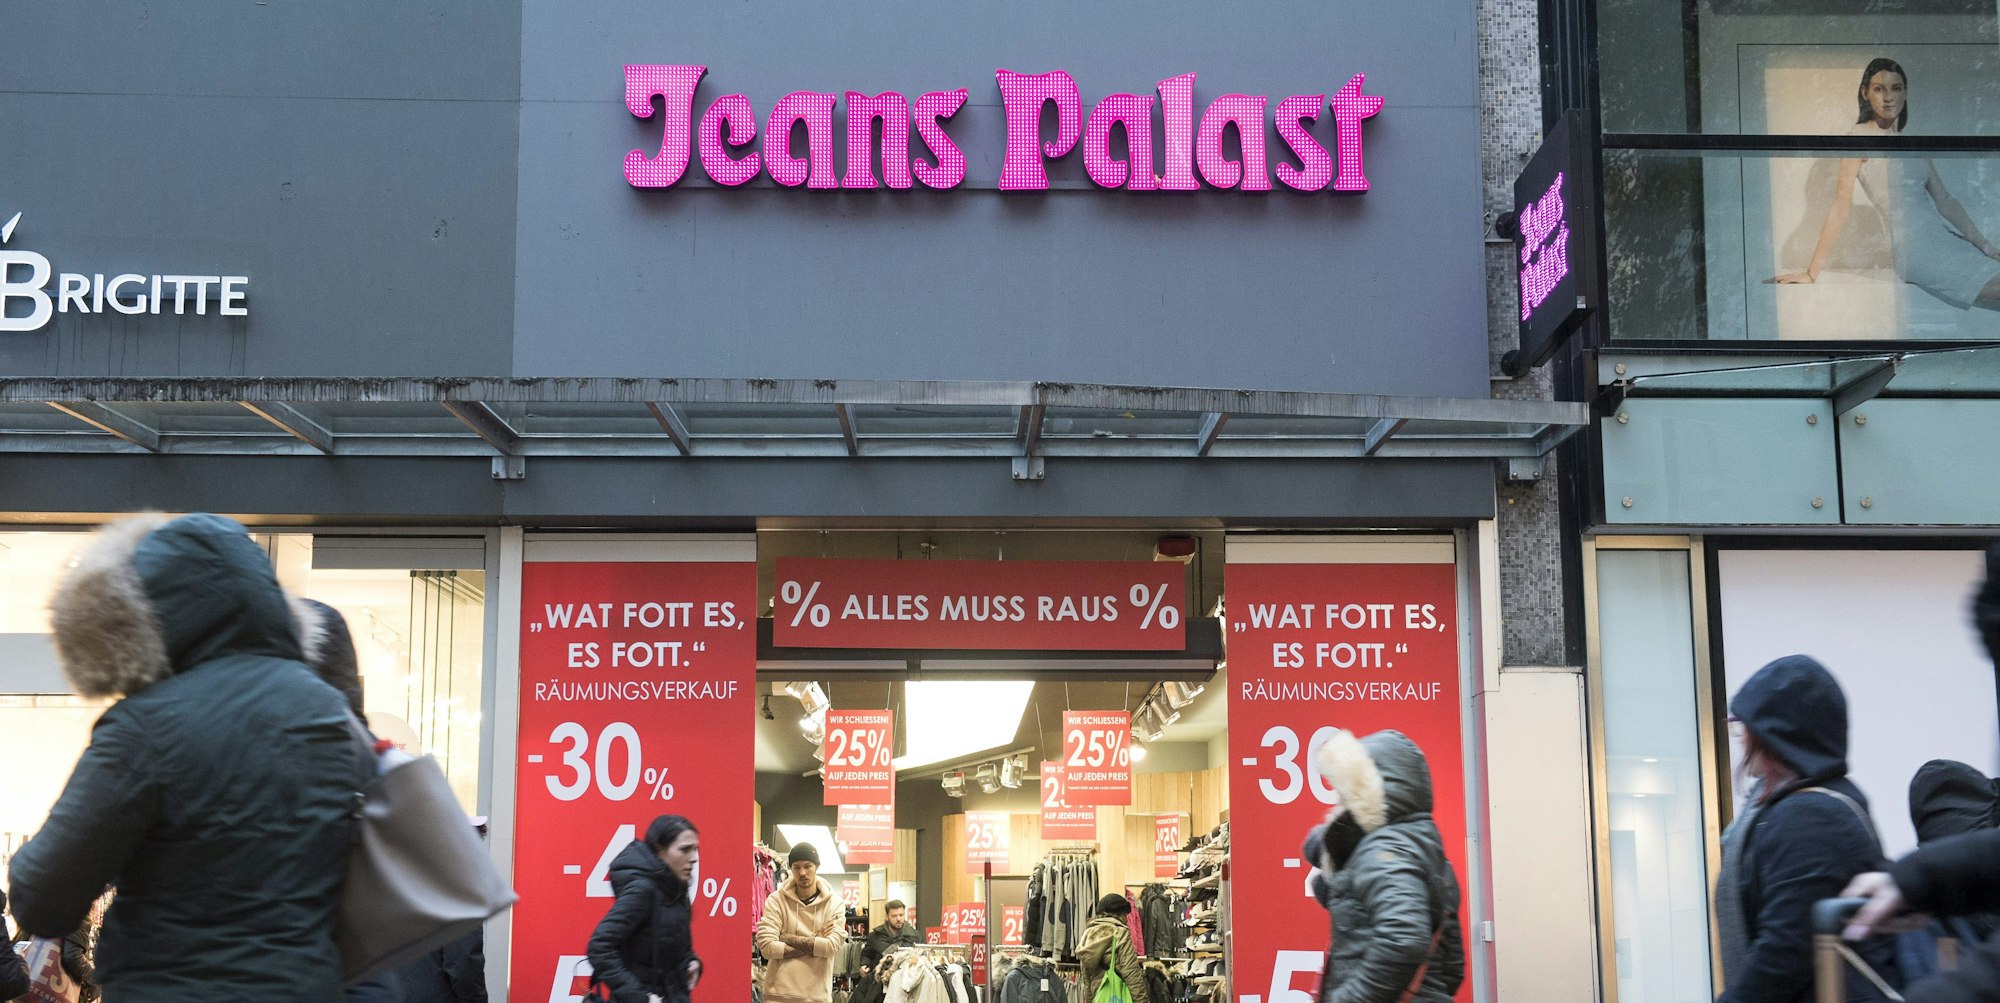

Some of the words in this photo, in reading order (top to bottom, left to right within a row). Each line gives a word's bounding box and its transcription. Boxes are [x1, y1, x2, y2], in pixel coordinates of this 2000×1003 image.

[622, 64, 969, 189] Jeans
[995, 69, 1385, 191] Palast
[623, 602, 694, 628] FOTT
[704, 601, 745, 630] ES,
[781, 580, 831, 628] %
[840, 594, 929, 622] ALLES
[939, 595, 1026, 622] MUSS
[1037, 595, 1119, 622] RAUS
[1129, 583, 1179, 630] %
[1325, 603, 1395, 629] FOTT
[1405, 603, 1446, 632] ES,
[568, 641, 600, 668] ES
[1273, 642, 1305, 668] ES
[535, 678, 738, 701] RÄUMUNGSVERKAUF
[1242, 678, 1441, 701] RÄUMUNGSVERKAUF
[829, 715, 844, 724] WIR
[1067, 716, 1082, 725] WIR
[828, 728, 890, 767] 25%
[1067, 729, 1129, 767] 25%
[828, 771, 844, 781] AUF
[844, 771, 868, 781] JEDEN
[869, 771, 889, 781] PREIS
[1068, 772, 1083, 781] AUF
[1083, 772, 1107, 781] JEDEN
[1108, 772, 1129, 781] PREIS
